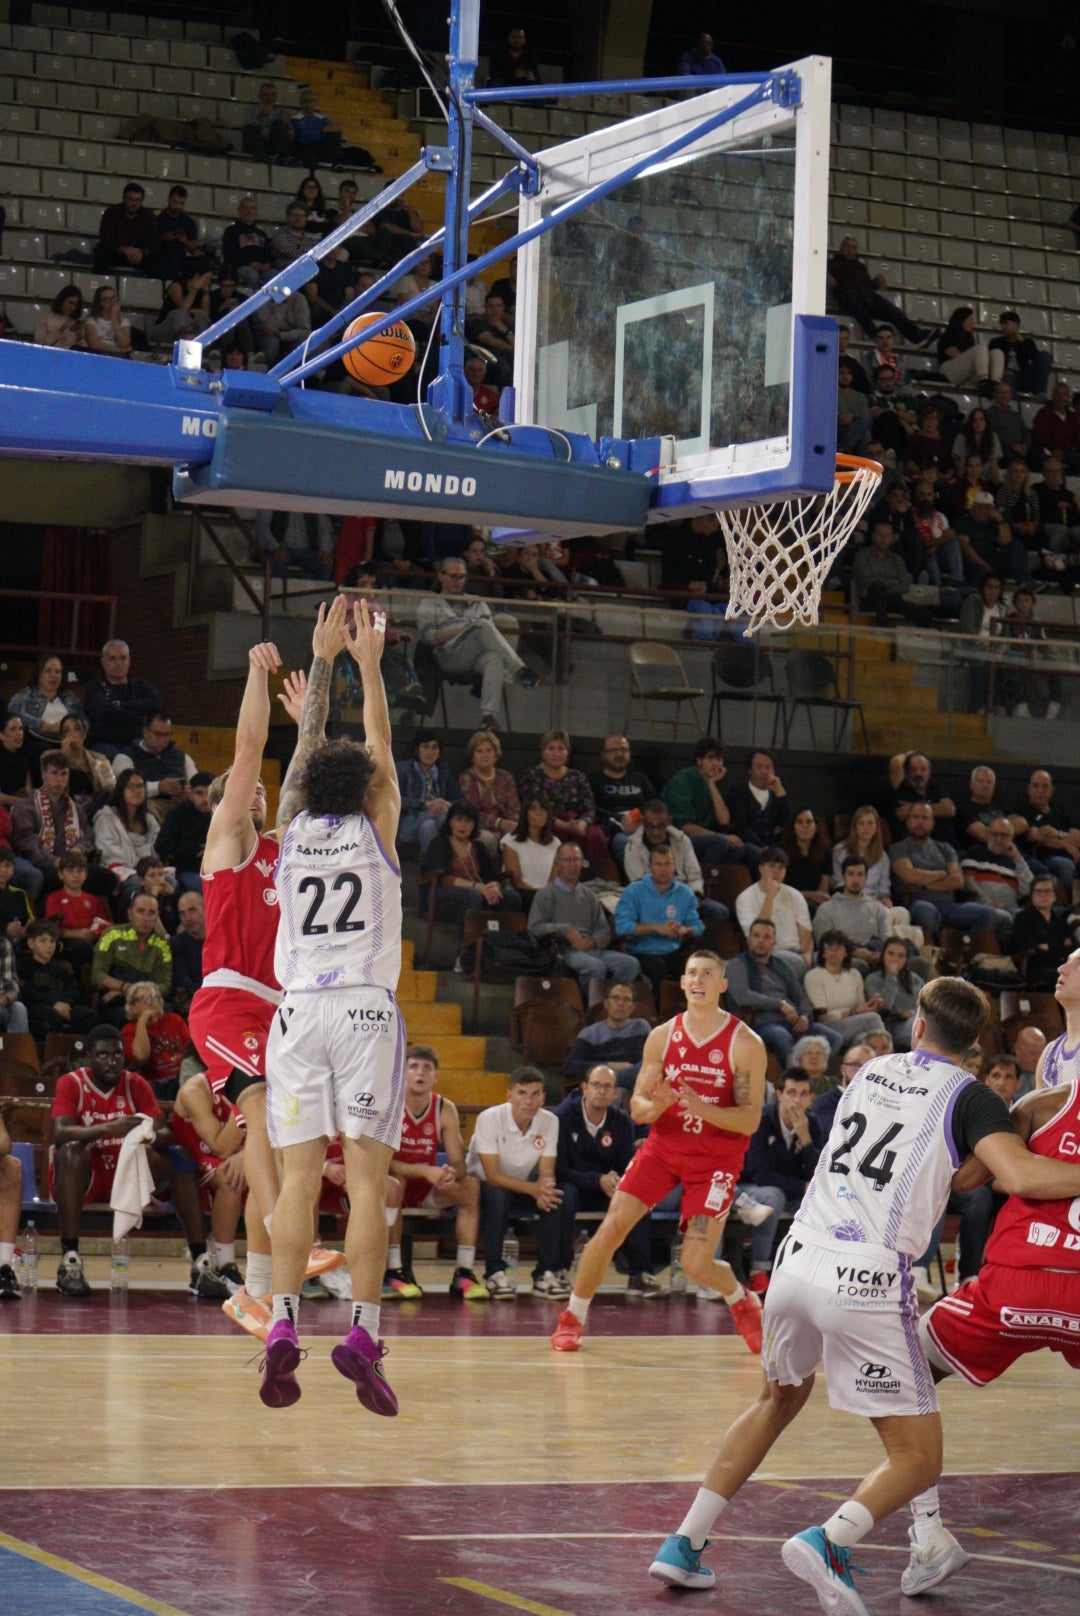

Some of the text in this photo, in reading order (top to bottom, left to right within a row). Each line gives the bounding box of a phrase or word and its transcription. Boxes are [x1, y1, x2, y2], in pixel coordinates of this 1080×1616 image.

[384, 470, 477, 496] MONDO
[296, 843, 360, 856] SANTANA
[298, 872, 366, 936] 22
[347, 1008, 394, 1023] VICKY
[865, 1073, 929, 1097] BELLVER
[683, 1113, 703, 1134] 23
[829, 1111, 904, 1192] 24
[836, 1266, 897, 1287] VICKY
[837, 1285, 888, 1299] FOODS
[855, 1379, 901, 1389] HYUNDAI
